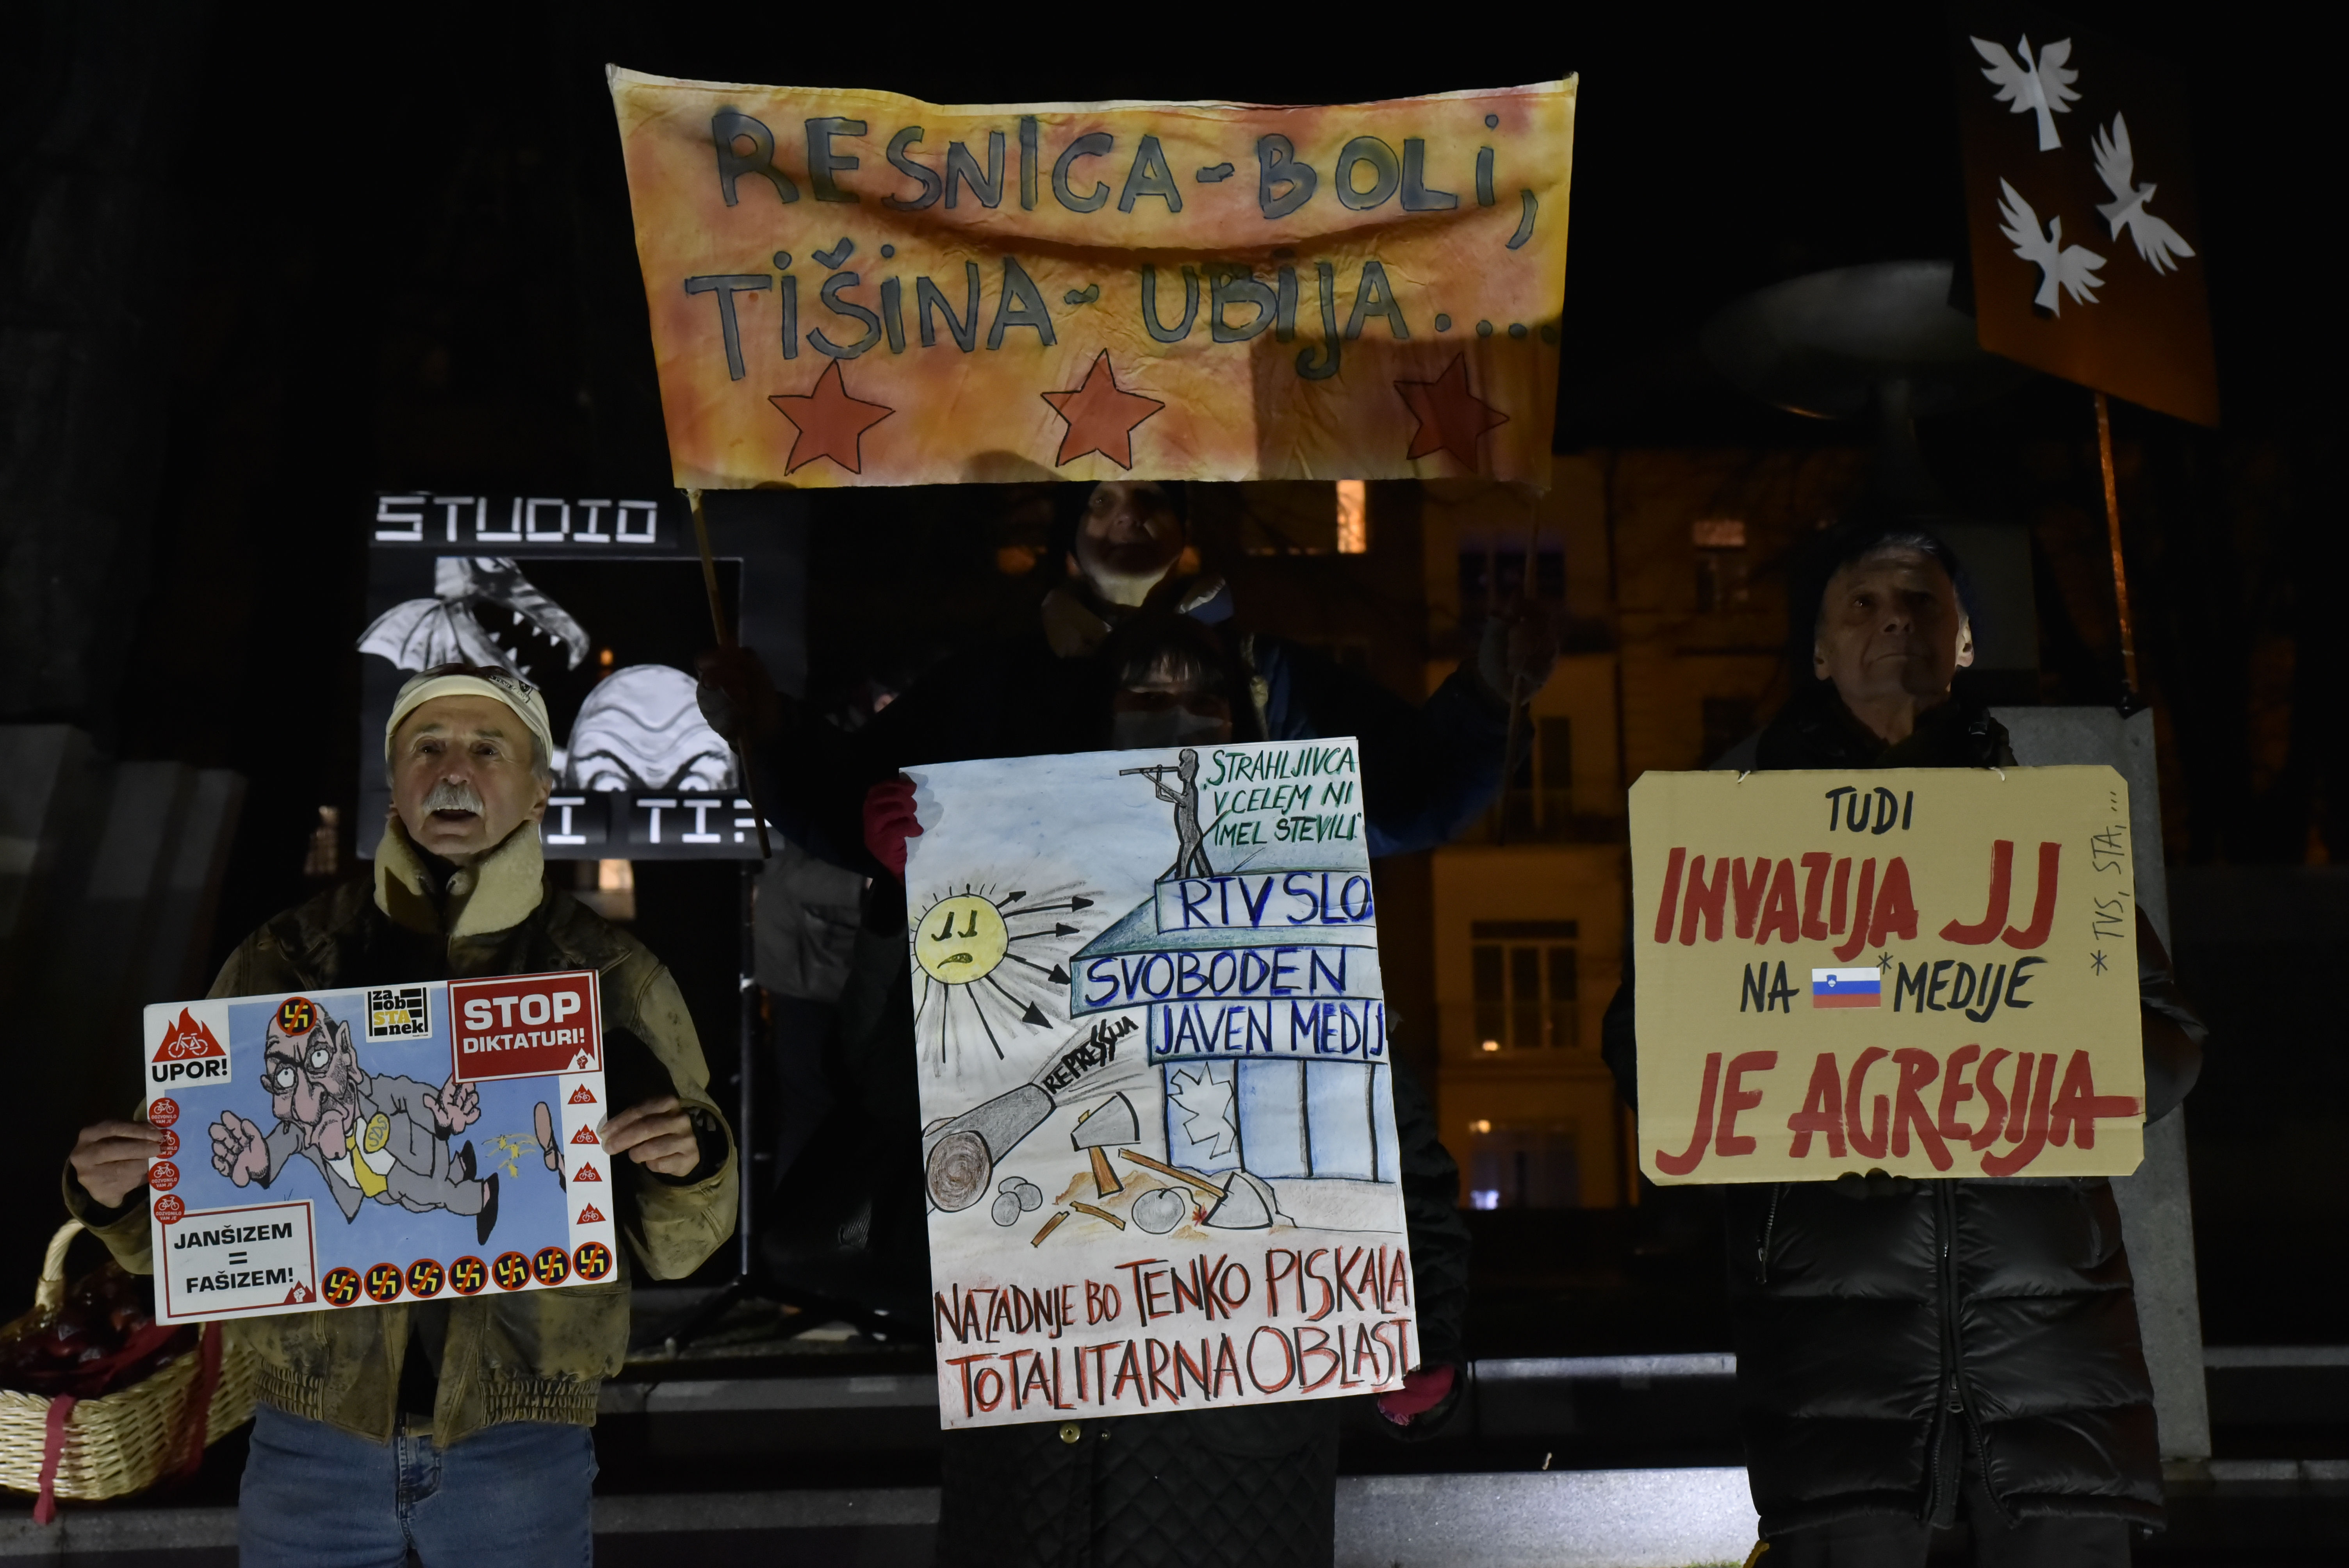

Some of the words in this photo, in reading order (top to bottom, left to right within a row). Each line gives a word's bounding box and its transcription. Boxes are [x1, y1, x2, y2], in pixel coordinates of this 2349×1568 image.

[375, 496, 657, 543] STUDIO
[1320, 781, 1355, 808] NI
[1825, 786, 1914, 836] TUDI
[1215, 821, 1267, 847] IMEL
[1654, 846, 1919, 963] INVAZIJA
[1938, 839, 2062, 950] JJ
[1084, 944, 1347, 1007] SVOBODEN
[1740, 960, 1800, 1014] NA
[373, 1010, 411, 1025] STA
[389, 1019, 424, 1035] nek
[464, 991, 581, 1030] STOP
[463, 1028, 585, 1053] DIKTATURI!
[1155, 1001, 1273, 1055] JAVEN
[1291, 999, 1384, 1060] MEDIJ
[151, 1058, 228, 1083] UPOR!
[1655, 1050, 1779, 1176] JE
[1787, 1043, 2145, 1177] AGRESIJA
[367, 1115, 389, 1147] SDS
[174, 1222, 292, 1249] JANŠIZEM
[186, 1267, 294, 1294] FAŠIZEM!
[934, 1283, 1078, 1344] NAZADNJE
[1084, 1279, 1122, 1326] BO
[1114, 1254, 1251, 1327] TENKO
